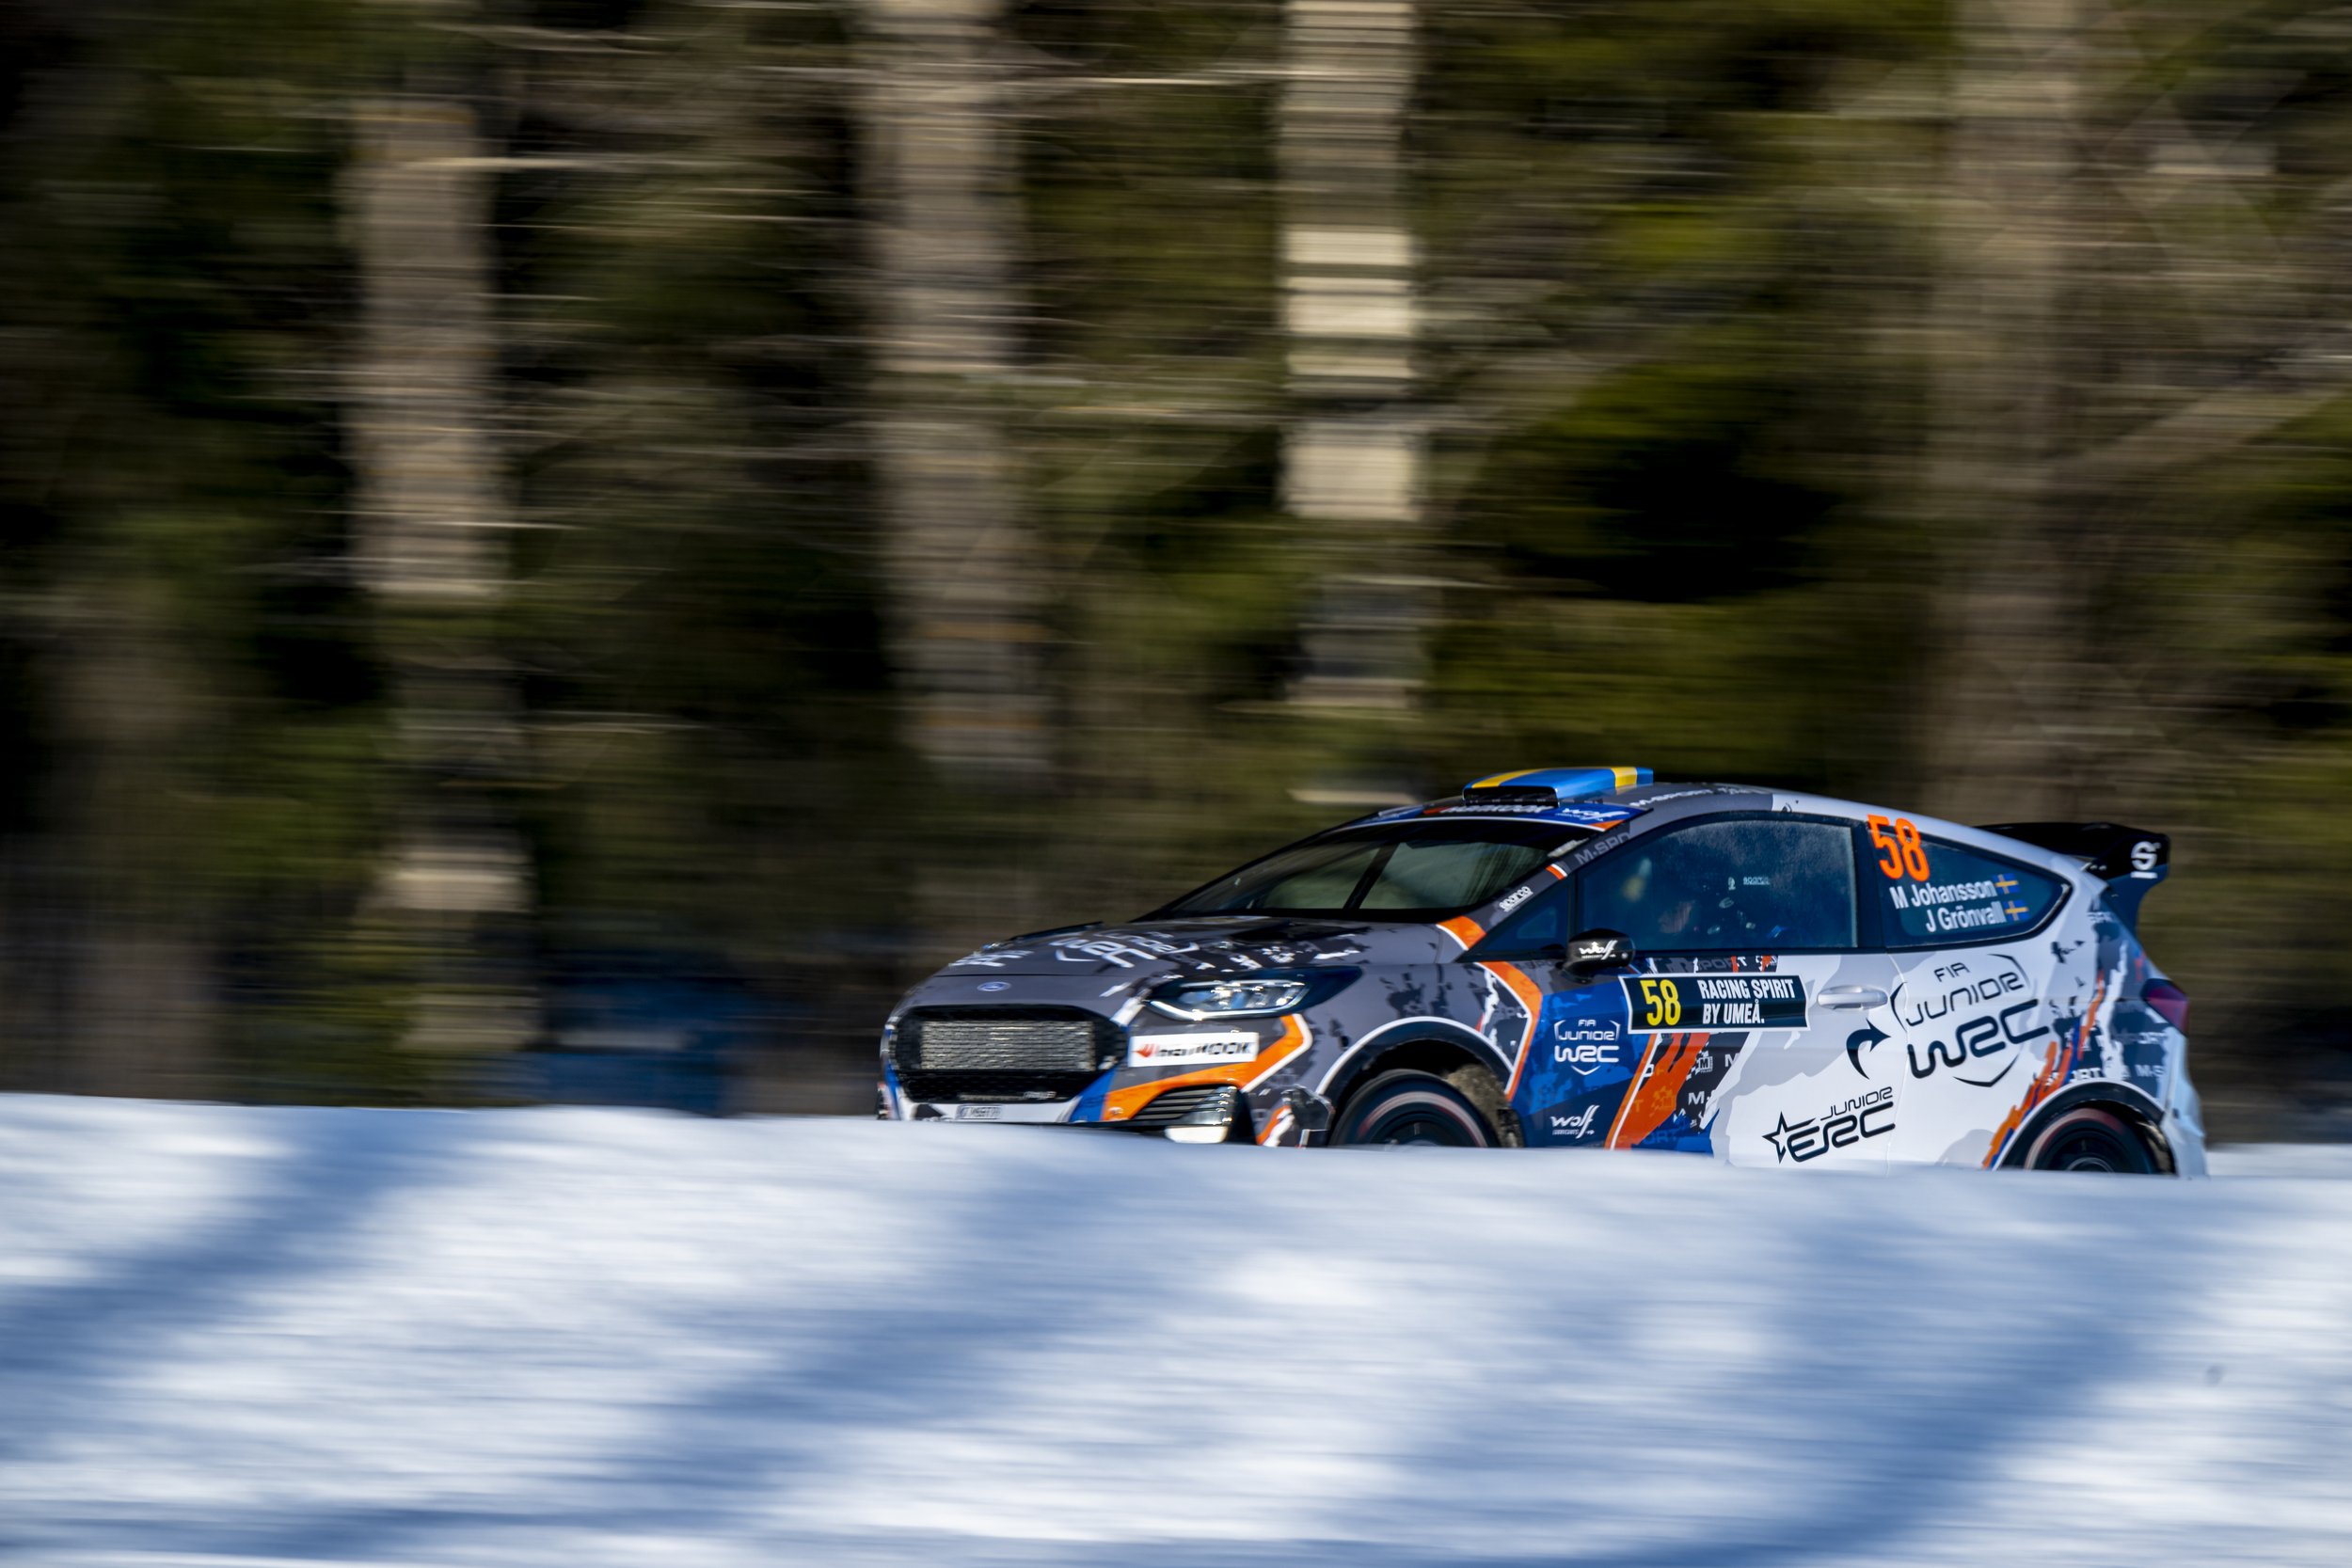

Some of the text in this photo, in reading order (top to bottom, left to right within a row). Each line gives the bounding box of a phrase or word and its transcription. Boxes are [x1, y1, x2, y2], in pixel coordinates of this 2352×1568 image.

[1867, 814, 1930, 881] 58
[1889, 879, 1998, 910] M Johansson
[1926, 900, 2007, 933] J Grönvall
[1579, 940, 1618, 960] wolf
[1934, 961, 1970, 983] FIA
[1640, 979, 1681, 1026] 58
[1697, 978, 1796, 1000] RACING SPIRIT
[1905, 971, 2025, 1027] JUNIOR
[1578, 1019, 1597, 1027] FIA
[1702, 999, 1765, 1024] BY UMEÅ.
[1558, 1030, 1615, 1041] JUNIOR
[1906, 999, 2050, 1079] WRC
[1554, 1045, 1620, 1063] WRC
[1820, 1085, 1894, 1122] JUNIOR
[1549, 1104, 1600, 1139] wolf
[1786, 1101, 1896, 1164] ERC
